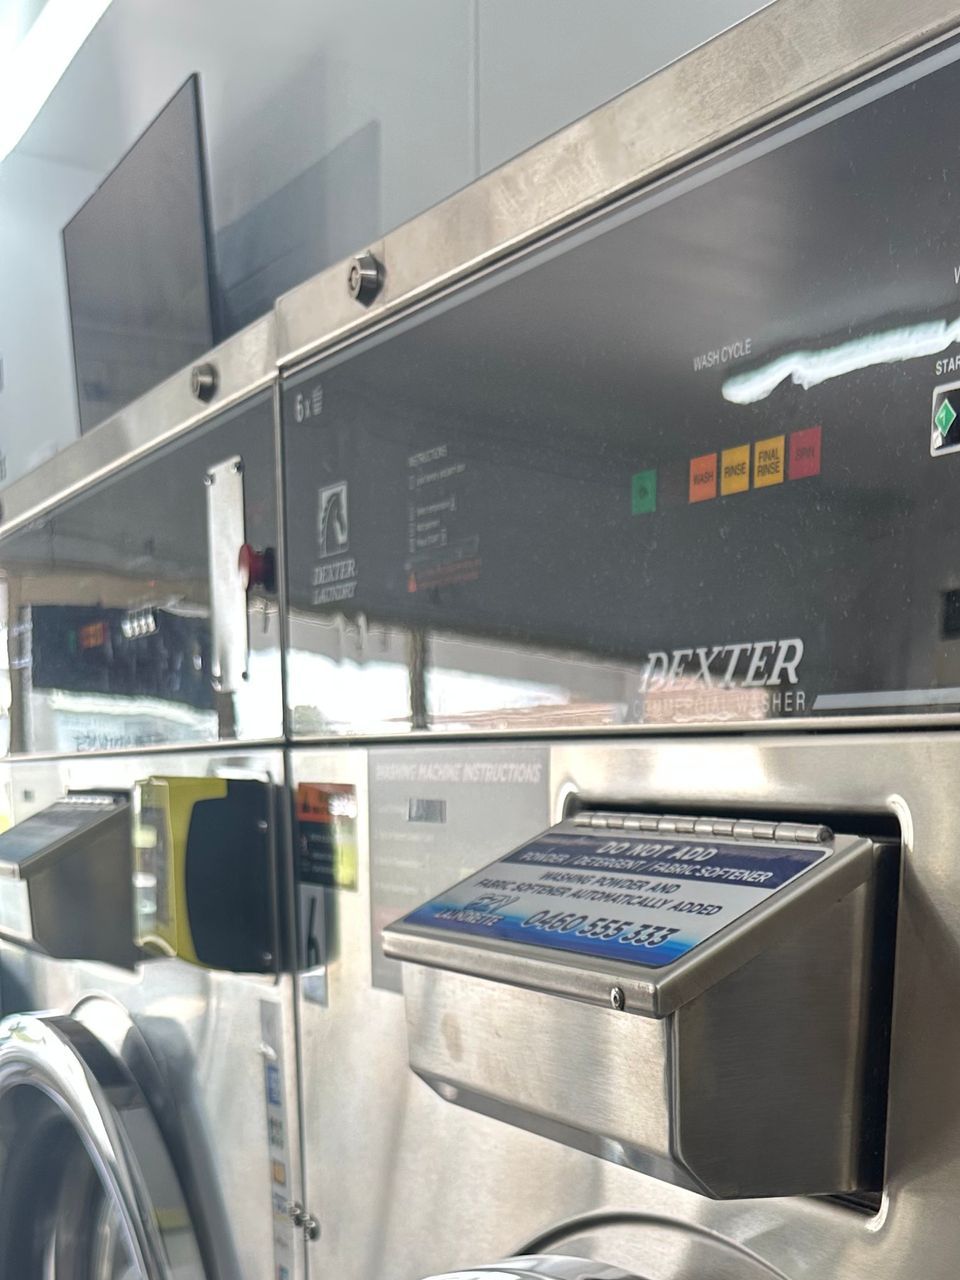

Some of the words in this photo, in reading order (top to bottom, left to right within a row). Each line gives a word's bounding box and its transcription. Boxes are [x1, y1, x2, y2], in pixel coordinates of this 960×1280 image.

[693, 349, 720, 373] WASH
[721, 338, 752, 363] CYCLE
[758, 447, 780, 462] FINAL
[694, 471, 714, 486] WASH
[724, 463, 747, 478] RINSE
[757, 461, 780, 478] RINSE
[312, 558, 356, 586] DEXTER
[638, 638, 804, 693] DEXTER
[416, 762, 462, 783] MACHINE
[462, 762, 543, 783] INSTRUCTIONS
[596, 840, 628, 854] DO
[629, 843, 670, 858] NOT
[668, 846, 719, 862] ADD
[519, 851, 570, 864] POWDER
[573, 854, 647, 871] DETERGENT
[649, 862, 701, 875] FABRIC
[695, 867, 774, 883] SOFTENER
[539, 871, 596, 884] WASHING
[594, 876, 651, 893] POWDER
[649, 883, 681, 894] AND
[474, 878, 517, 891] FABRIC
[510, 882, 573, 897] SOFTENER
[567, 887, 671, 910] AUTOMATICALLY
[668, 900, 723, 916] ADDED
[521, 909, 588, 933] 0460
[575, 918, 634, 940] 555
[618, 923, 681, 948] 333
